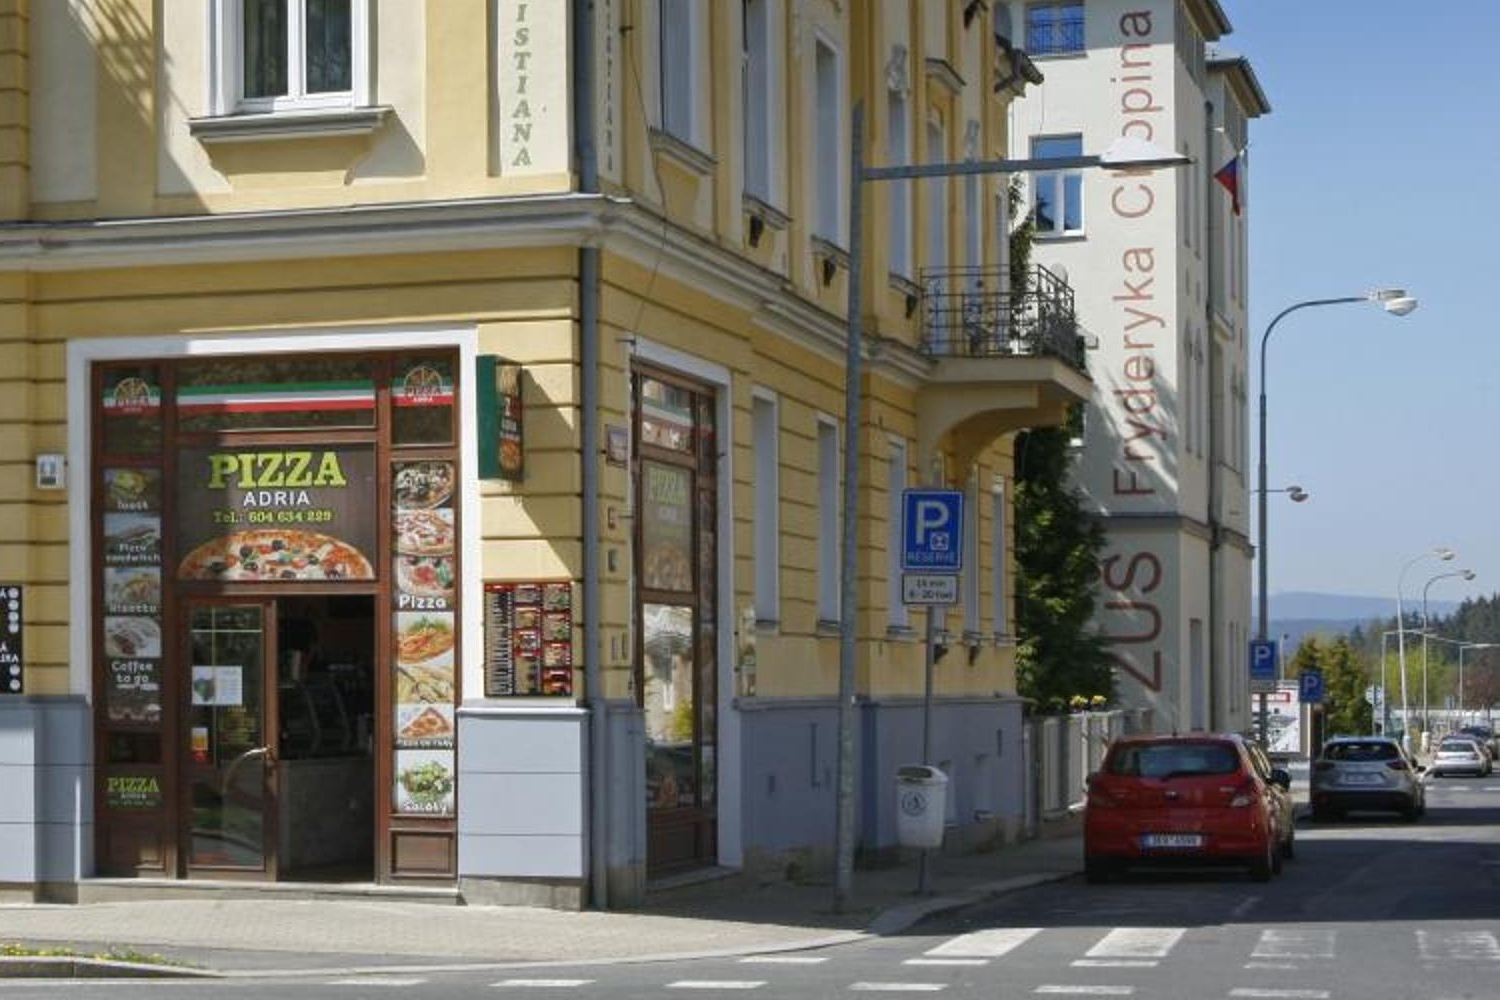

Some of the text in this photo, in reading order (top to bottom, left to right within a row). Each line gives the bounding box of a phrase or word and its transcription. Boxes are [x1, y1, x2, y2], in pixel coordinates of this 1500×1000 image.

[1112, 248, 1166, 496] Fryderyka
[207, 451, 347, 489] PIZZA
[243, 490, 311, 507] ADRIA
[916, 500, 949, 545] P
[399, 594, 447, 610] Pizza
[1255, 645, 1271, 666] P
[111, 660, 153, 674] Coffee
[116, 674, 149, 687] to go
[1303, 675, 1318, 693] P
[107, 776, 160, 793] PIZZA
